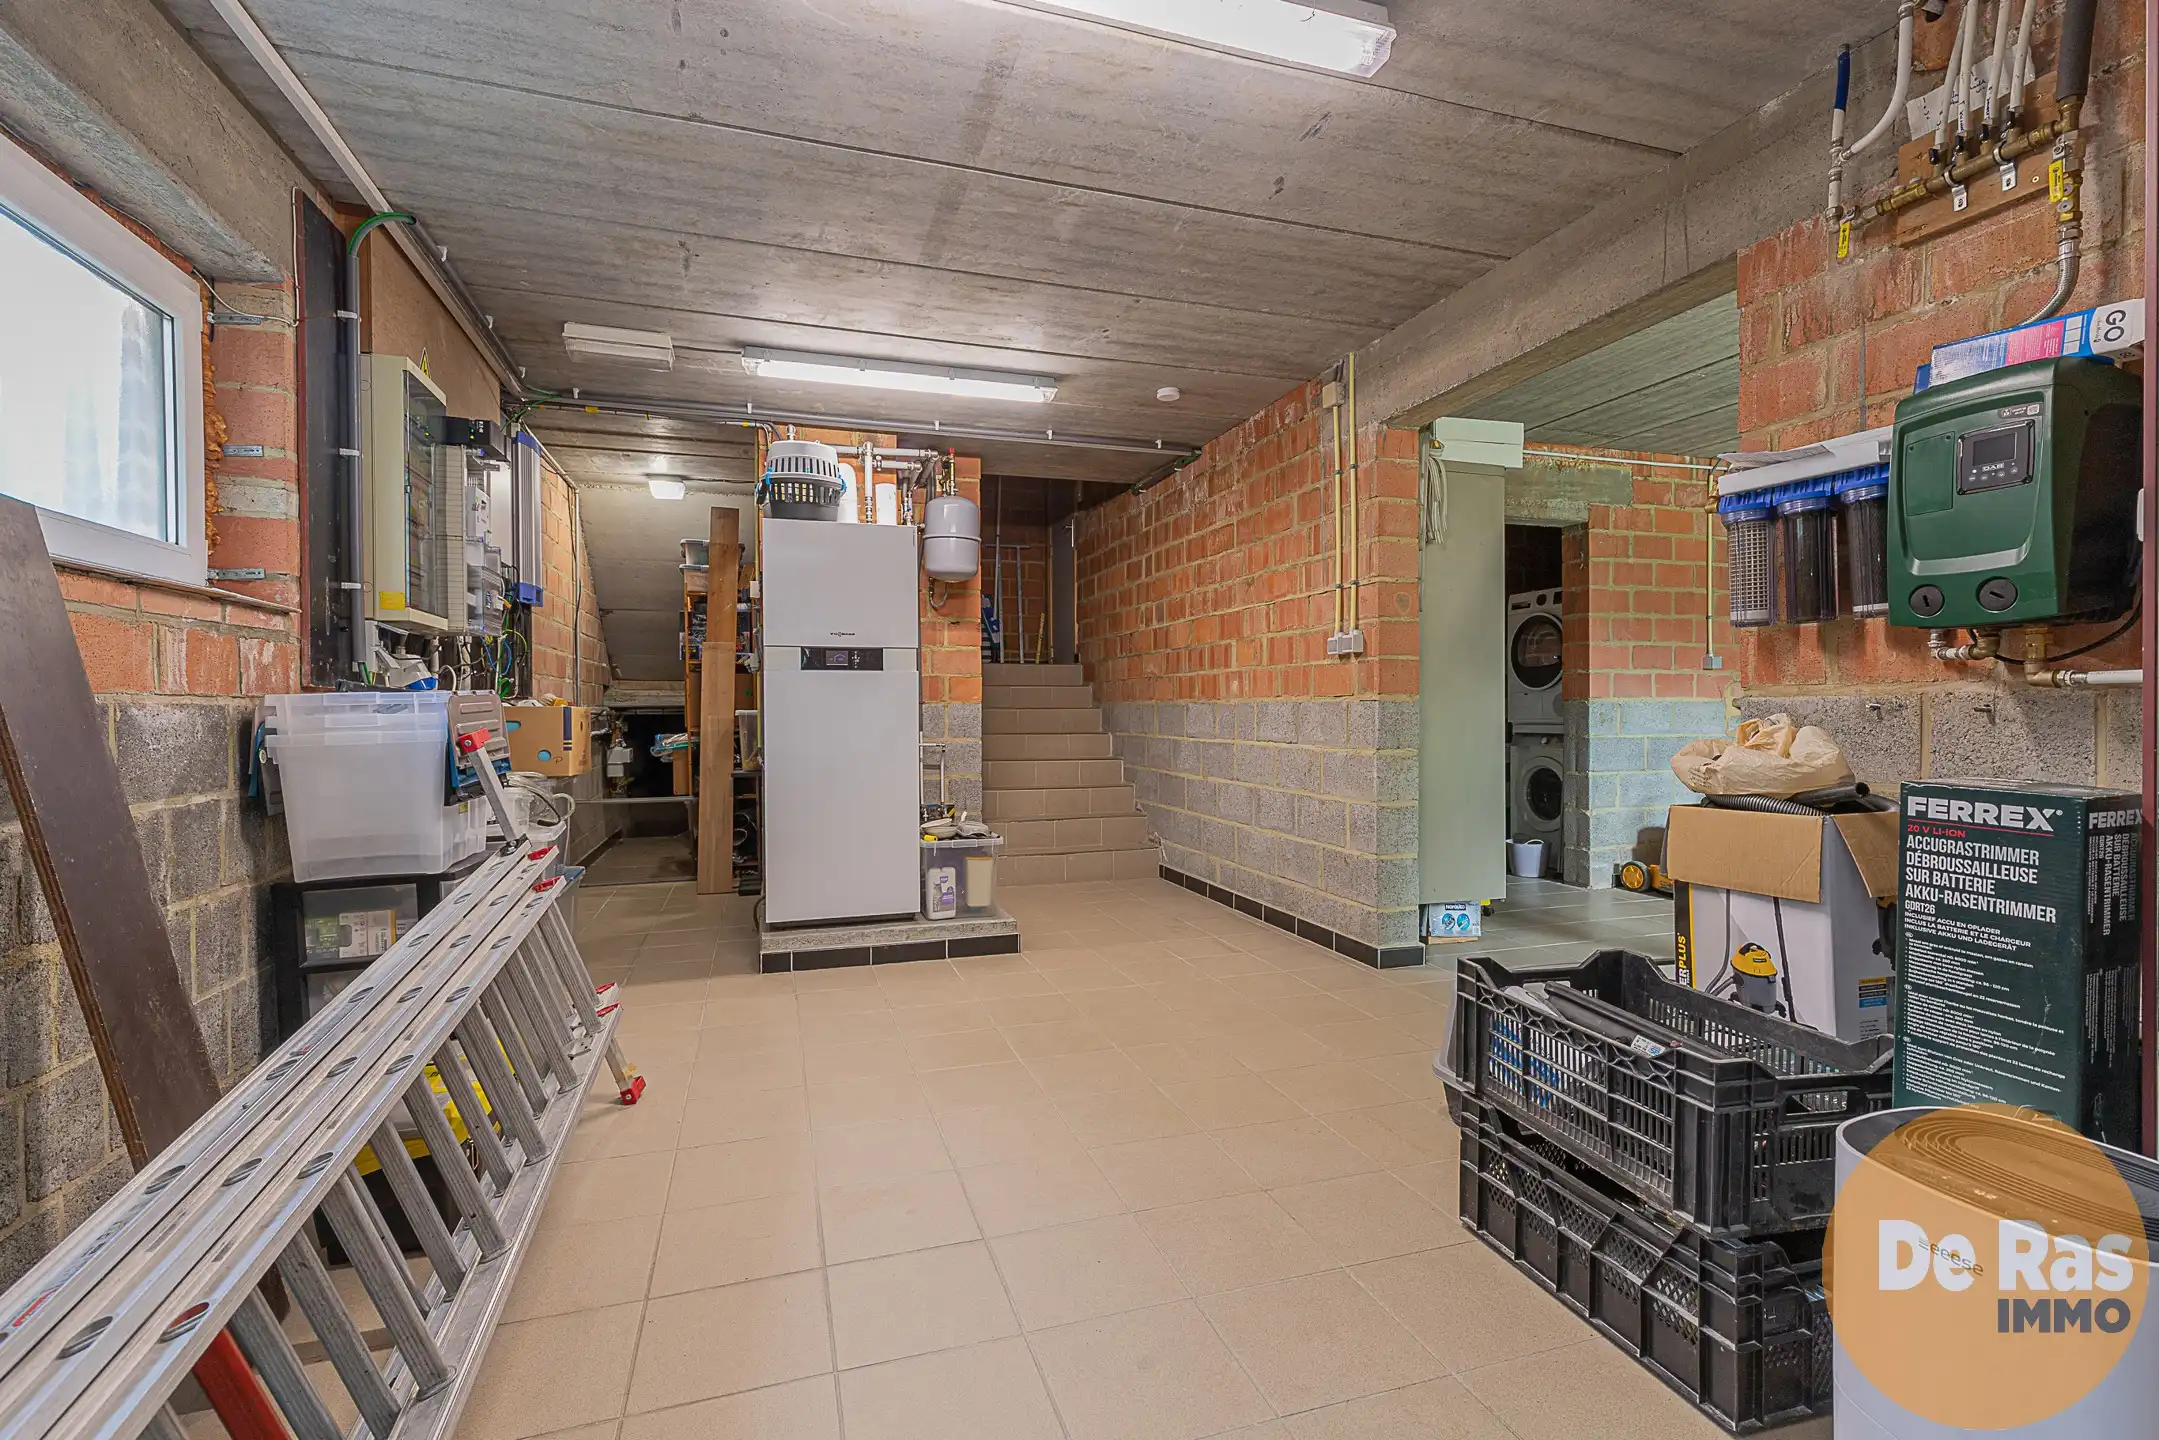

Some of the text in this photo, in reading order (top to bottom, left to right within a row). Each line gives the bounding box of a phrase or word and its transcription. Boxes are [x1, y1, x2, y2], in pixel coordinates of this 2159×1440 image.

[1907, 796, 2055, 832] FERREX
[1907, 824, 1966, 838] 20 V LI-ION
[1906, 834, 2040, 866] ACCUGRASTRIMMER
[1905, 867, 1996, 895] SUR BATTERIE
[1906, 850, 2038, 884] DÉBROUSSAILLEUSE
[2103, 835, 2113, 936] AKKU-RASENTRIMMER
[1904, 900, 1936, 914] GDRT26
[1905, 884, 2057, 923] AKKU-RASENTRIMMER
[1904, 911, 1936, 922] INCLUSIEF
[1937, 917, 1956, 926] ACCU
[1967, 923, 2001, 935] OPLADER
[1904, 917, 1927, 927] INCLUS
[1937, 924, 1969, 935] BATTERIE
[1990, 934, 2031, 948] CHARGEUR
[1904, 923, 1936, 935] INKLUSIVE
[1937, 929, 1956, 939] AKKU
[1957, 934, 1973, 942] UND
[1677, 935, 1687, 986] ERPLUS
